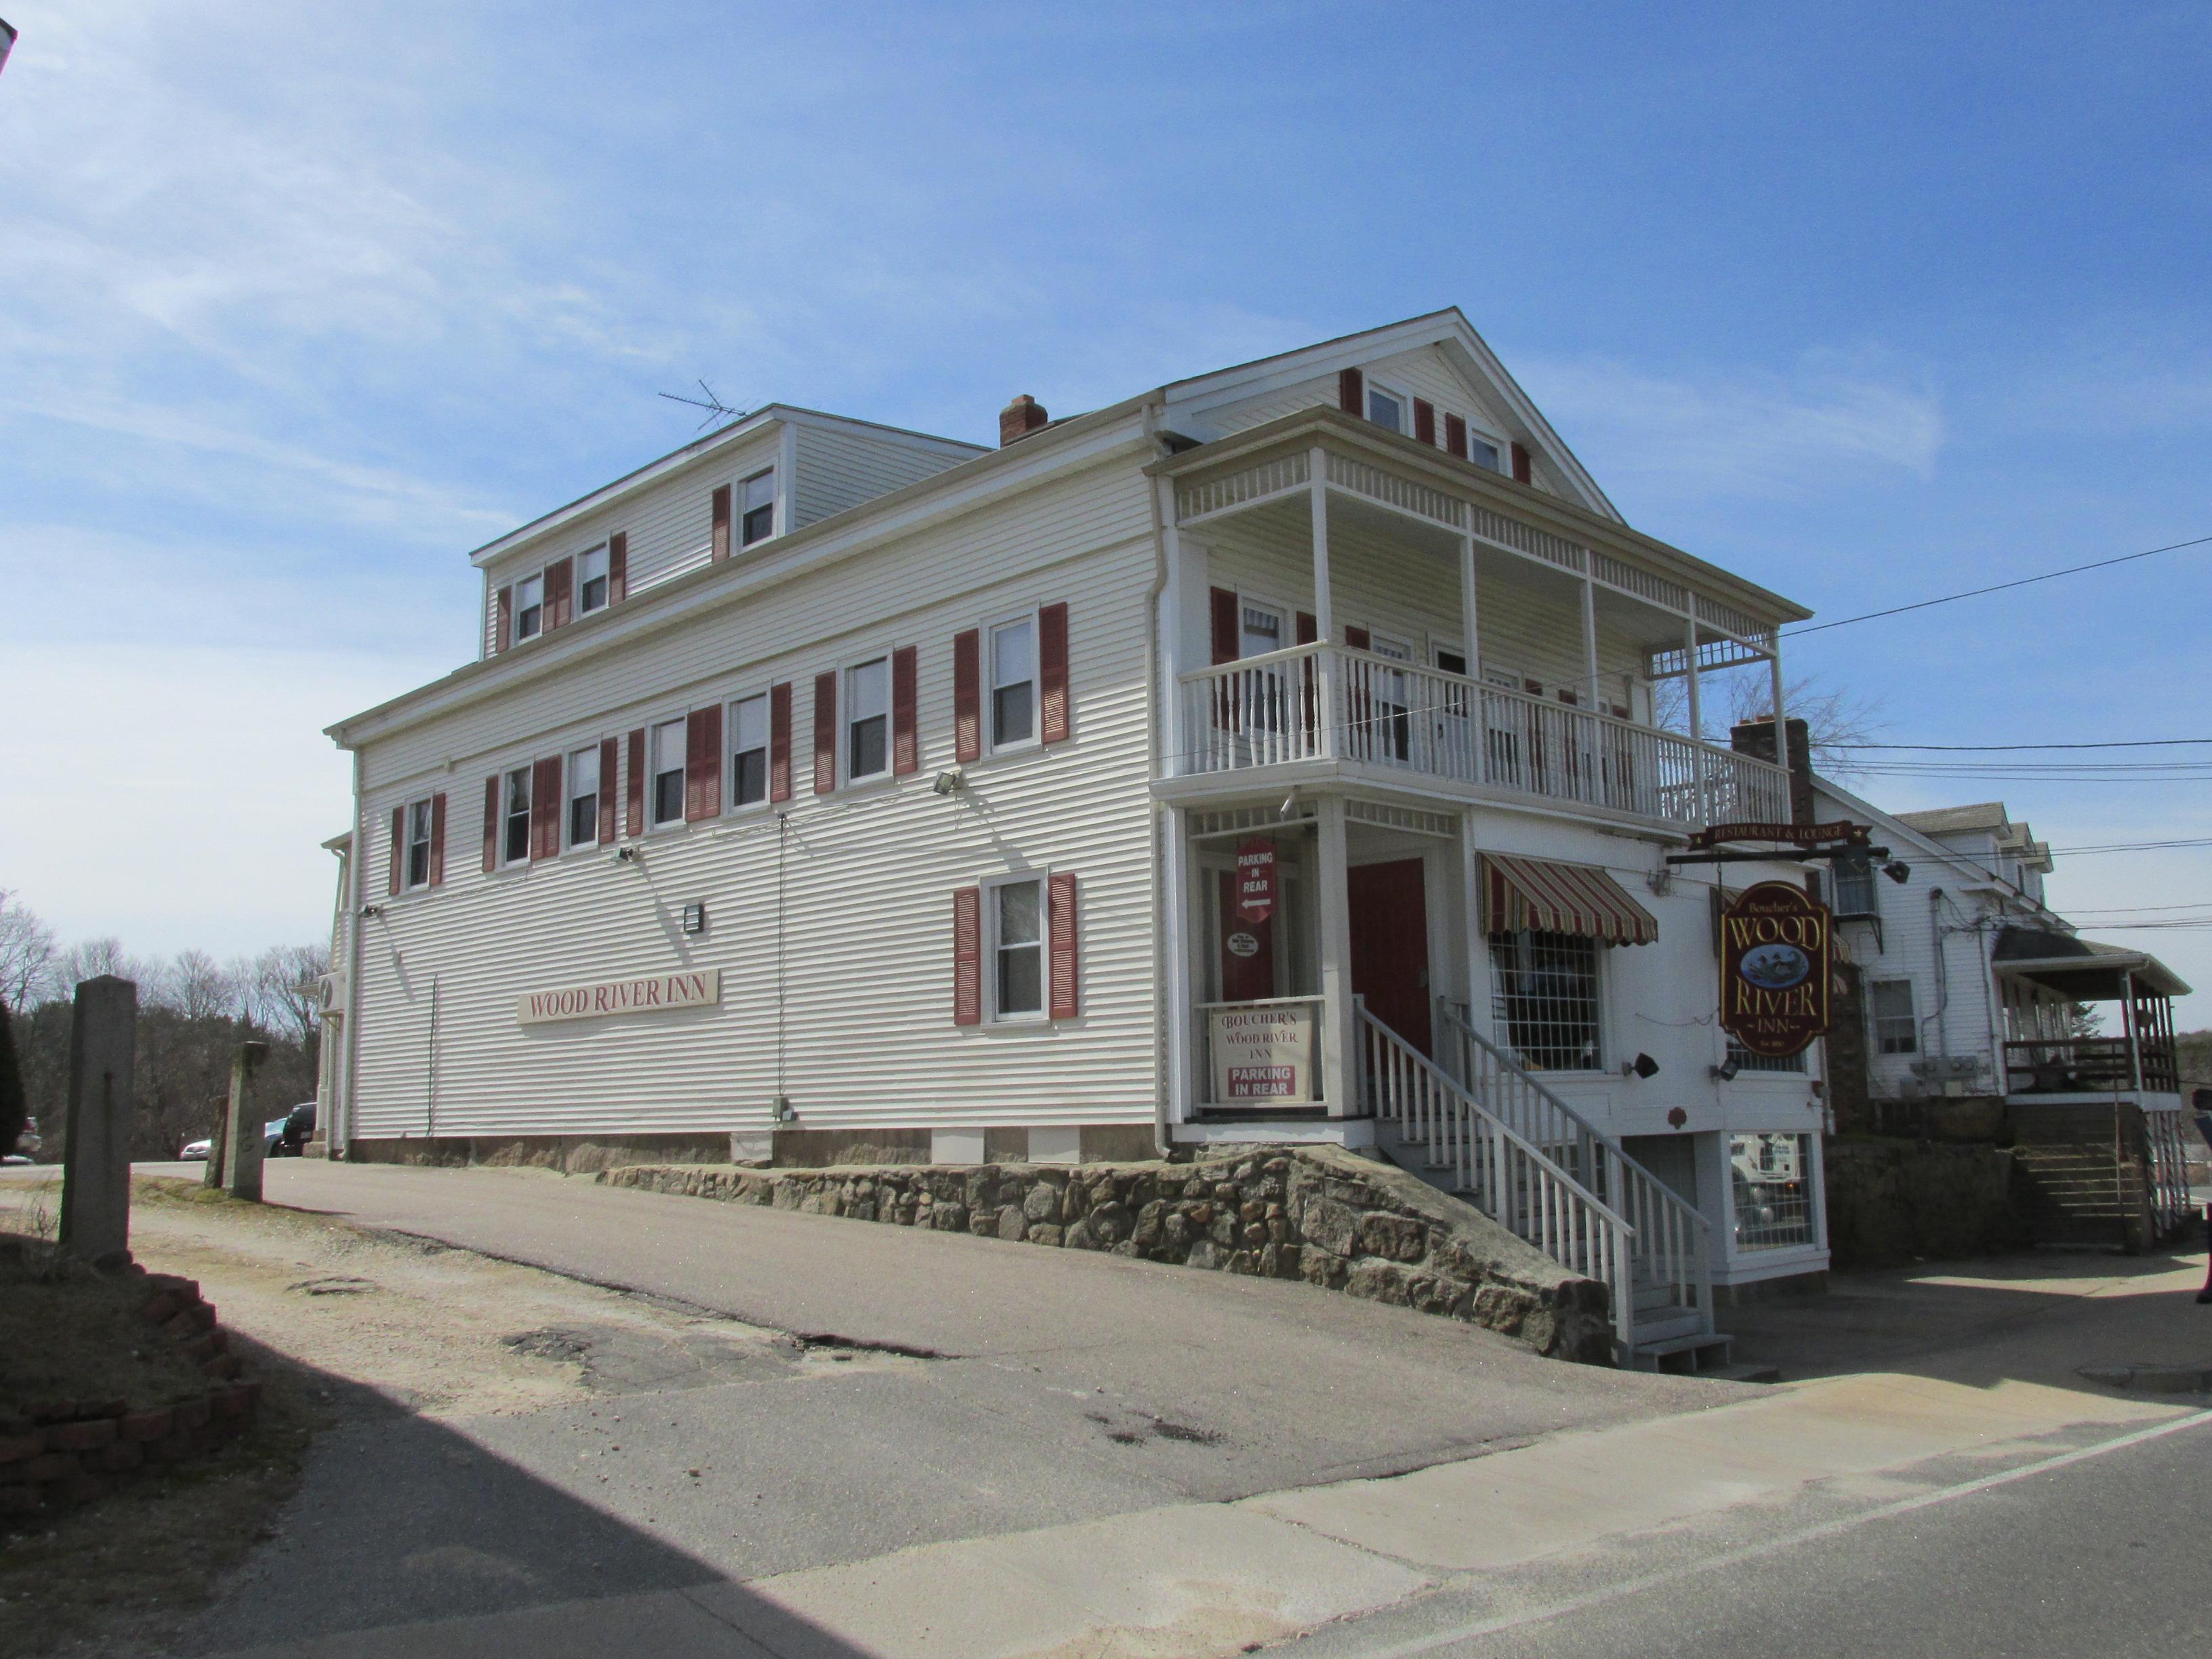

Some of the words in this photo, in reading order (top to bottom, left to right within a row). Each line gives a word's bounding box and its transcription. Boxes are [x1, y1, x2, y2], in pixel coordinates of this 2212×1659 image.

[1715, 825, 1782, 840] RESTAURANT
[1785, 830, 1795, 839] &
[1799, 825, 1841, 840] LOUNGE
[1238, 852, 1273, 866] PARKING
[1251, 868, 1259, 878] IN
[1243, 880, 1268, 893] REAR
[1728, 916, 1820, 951] WOOD
[529, 989, 588, 1018] WOOD
[594, 980, 660, 1012] RIVER
[665, 973, 706, 1003] INN
[1735, 975, 1817, 1016] RIVER
[1221, 1012, 1297, 1029] BOUCHER'S
[1757, 1018, 1789, 1033] INN
[1226, 1031, 1260, 1045] WOOD
[1263, 1030, 1298, 1044] RIVER
[1250, 1049, 1273, 1059] INN
[1232, 1067, 1291, 1080] PARKING
[1235, 1084, 1248, 1095] IN
[1253, 1083, 1288, 1095] REAR
